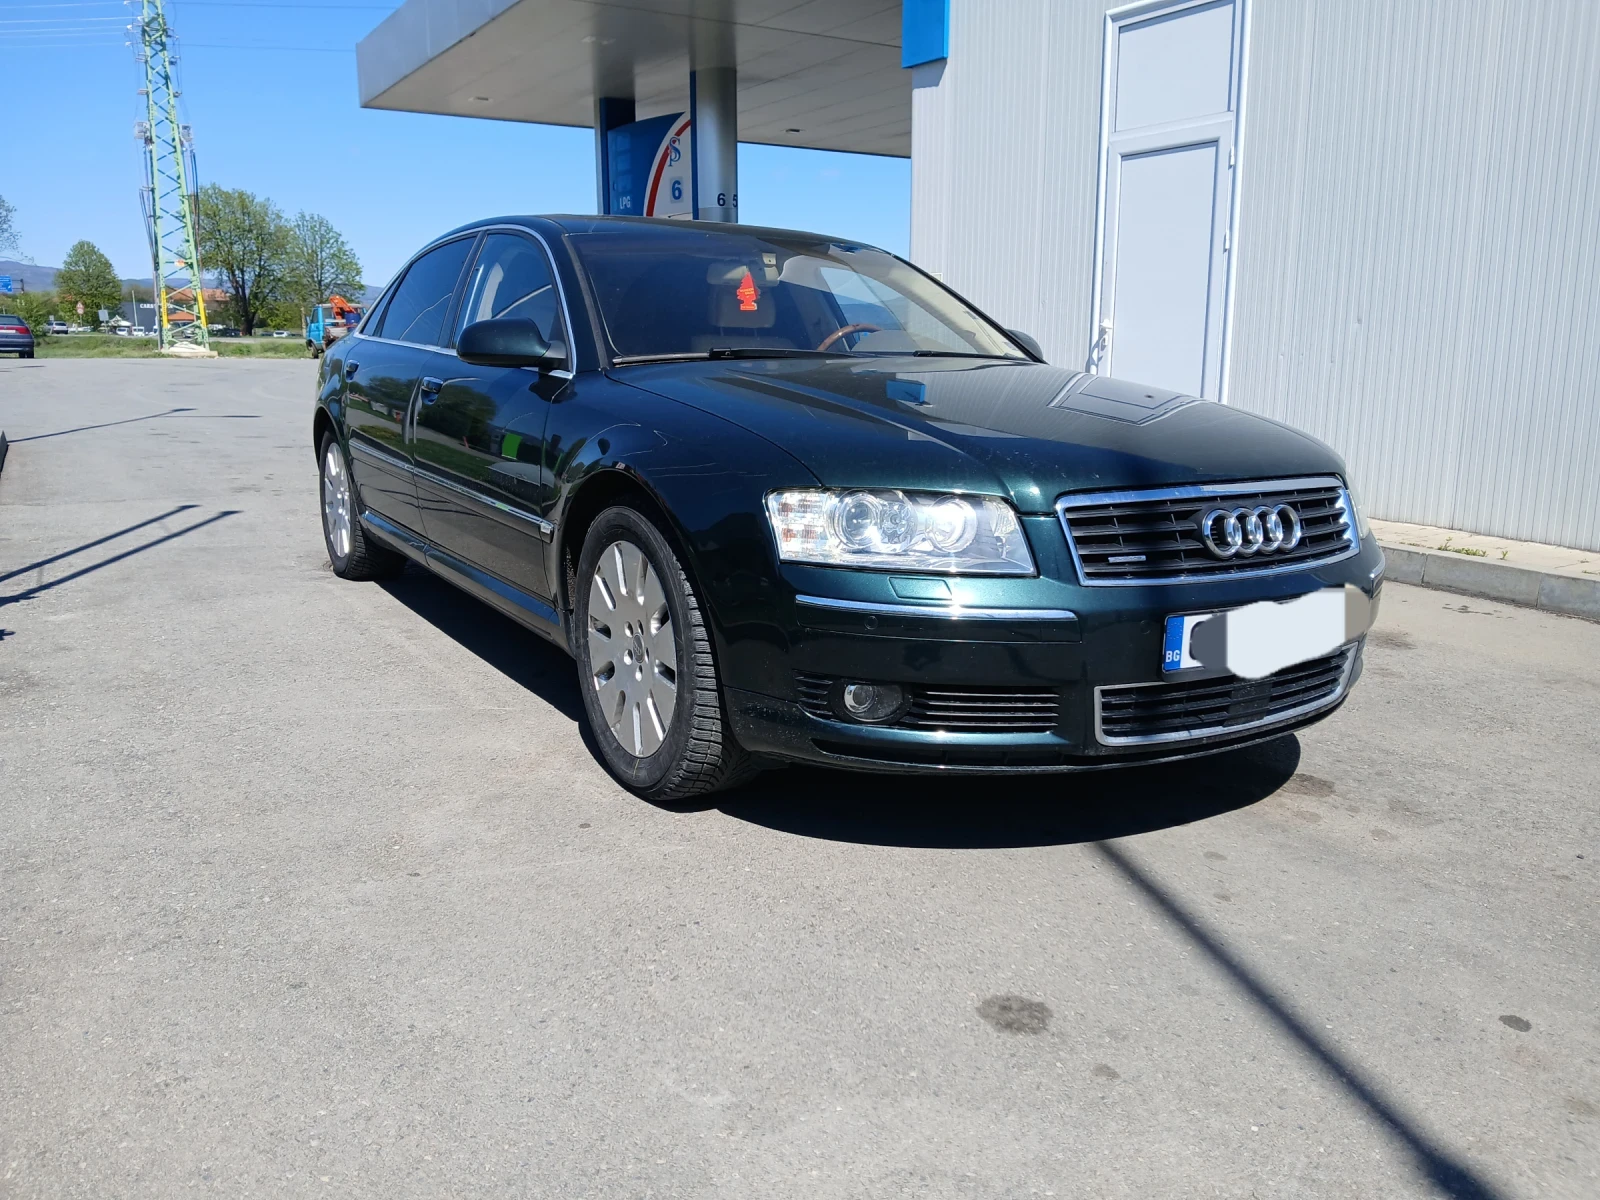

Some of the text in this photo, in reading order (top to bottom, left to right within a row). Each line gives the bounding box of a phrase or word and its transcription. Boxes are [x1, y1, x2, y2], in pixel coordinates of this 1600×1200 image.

[671, 180, 682, 201] 6
[620, 196, 631, 209] LPG
[717, 192, 726, 207] 6
[1165, 650, 1180, 662] BG
